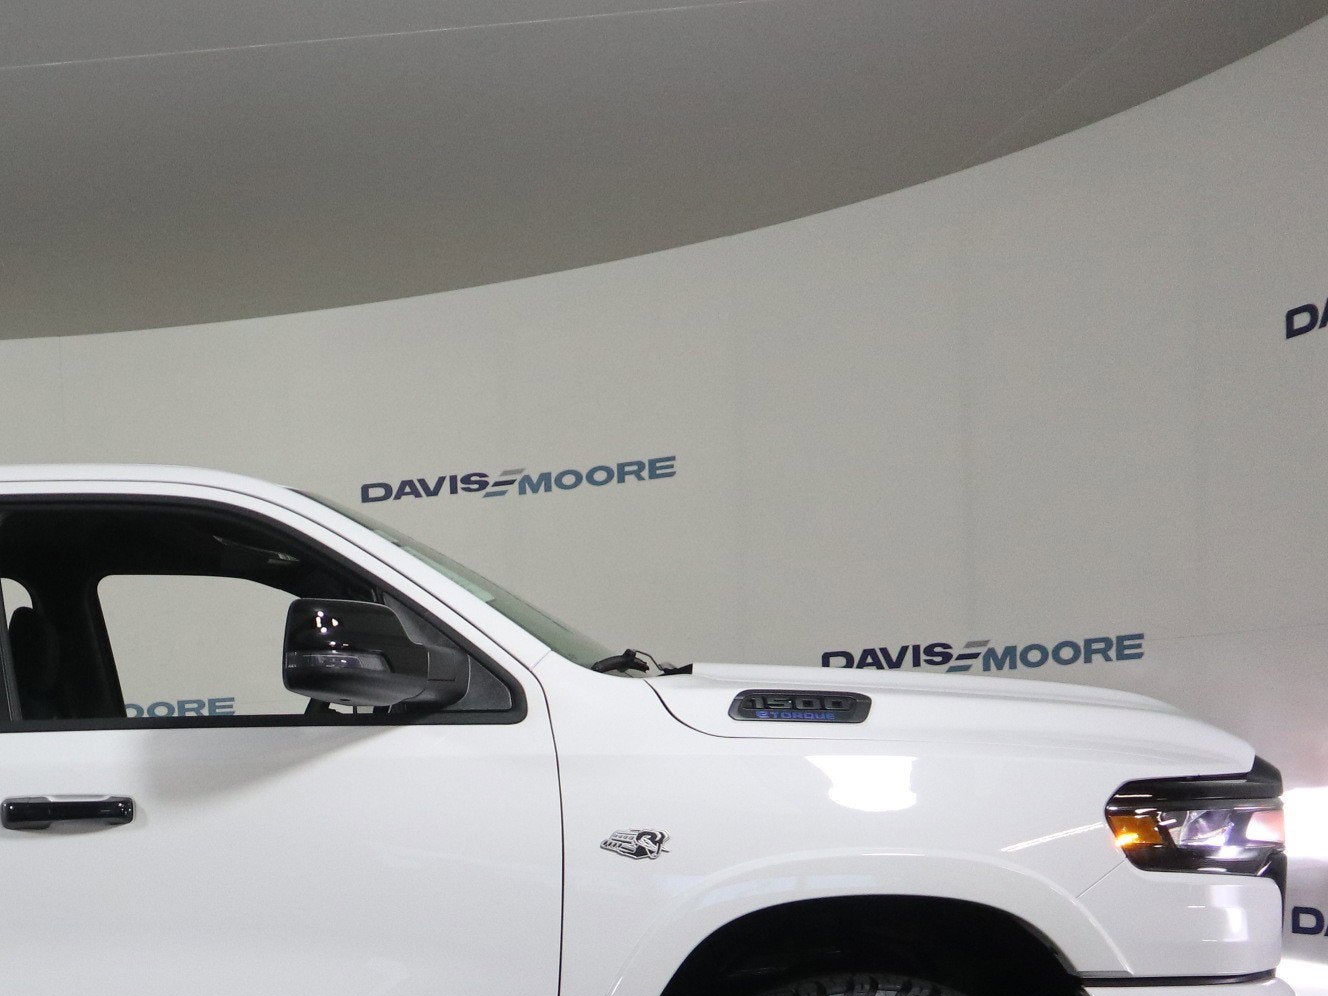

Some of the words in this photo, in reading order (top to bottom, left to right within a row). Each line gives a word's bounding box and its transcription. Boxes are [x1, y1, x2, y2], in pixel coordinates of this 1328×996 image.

[361, 472, 489, 503] DAVIS
[518, 455, 676, 495] MOORE
[822, 642, 954, 670] DAVIS
[982, 633, 1145, 672] MOORE
[743, 695, 856, 712] 1500
